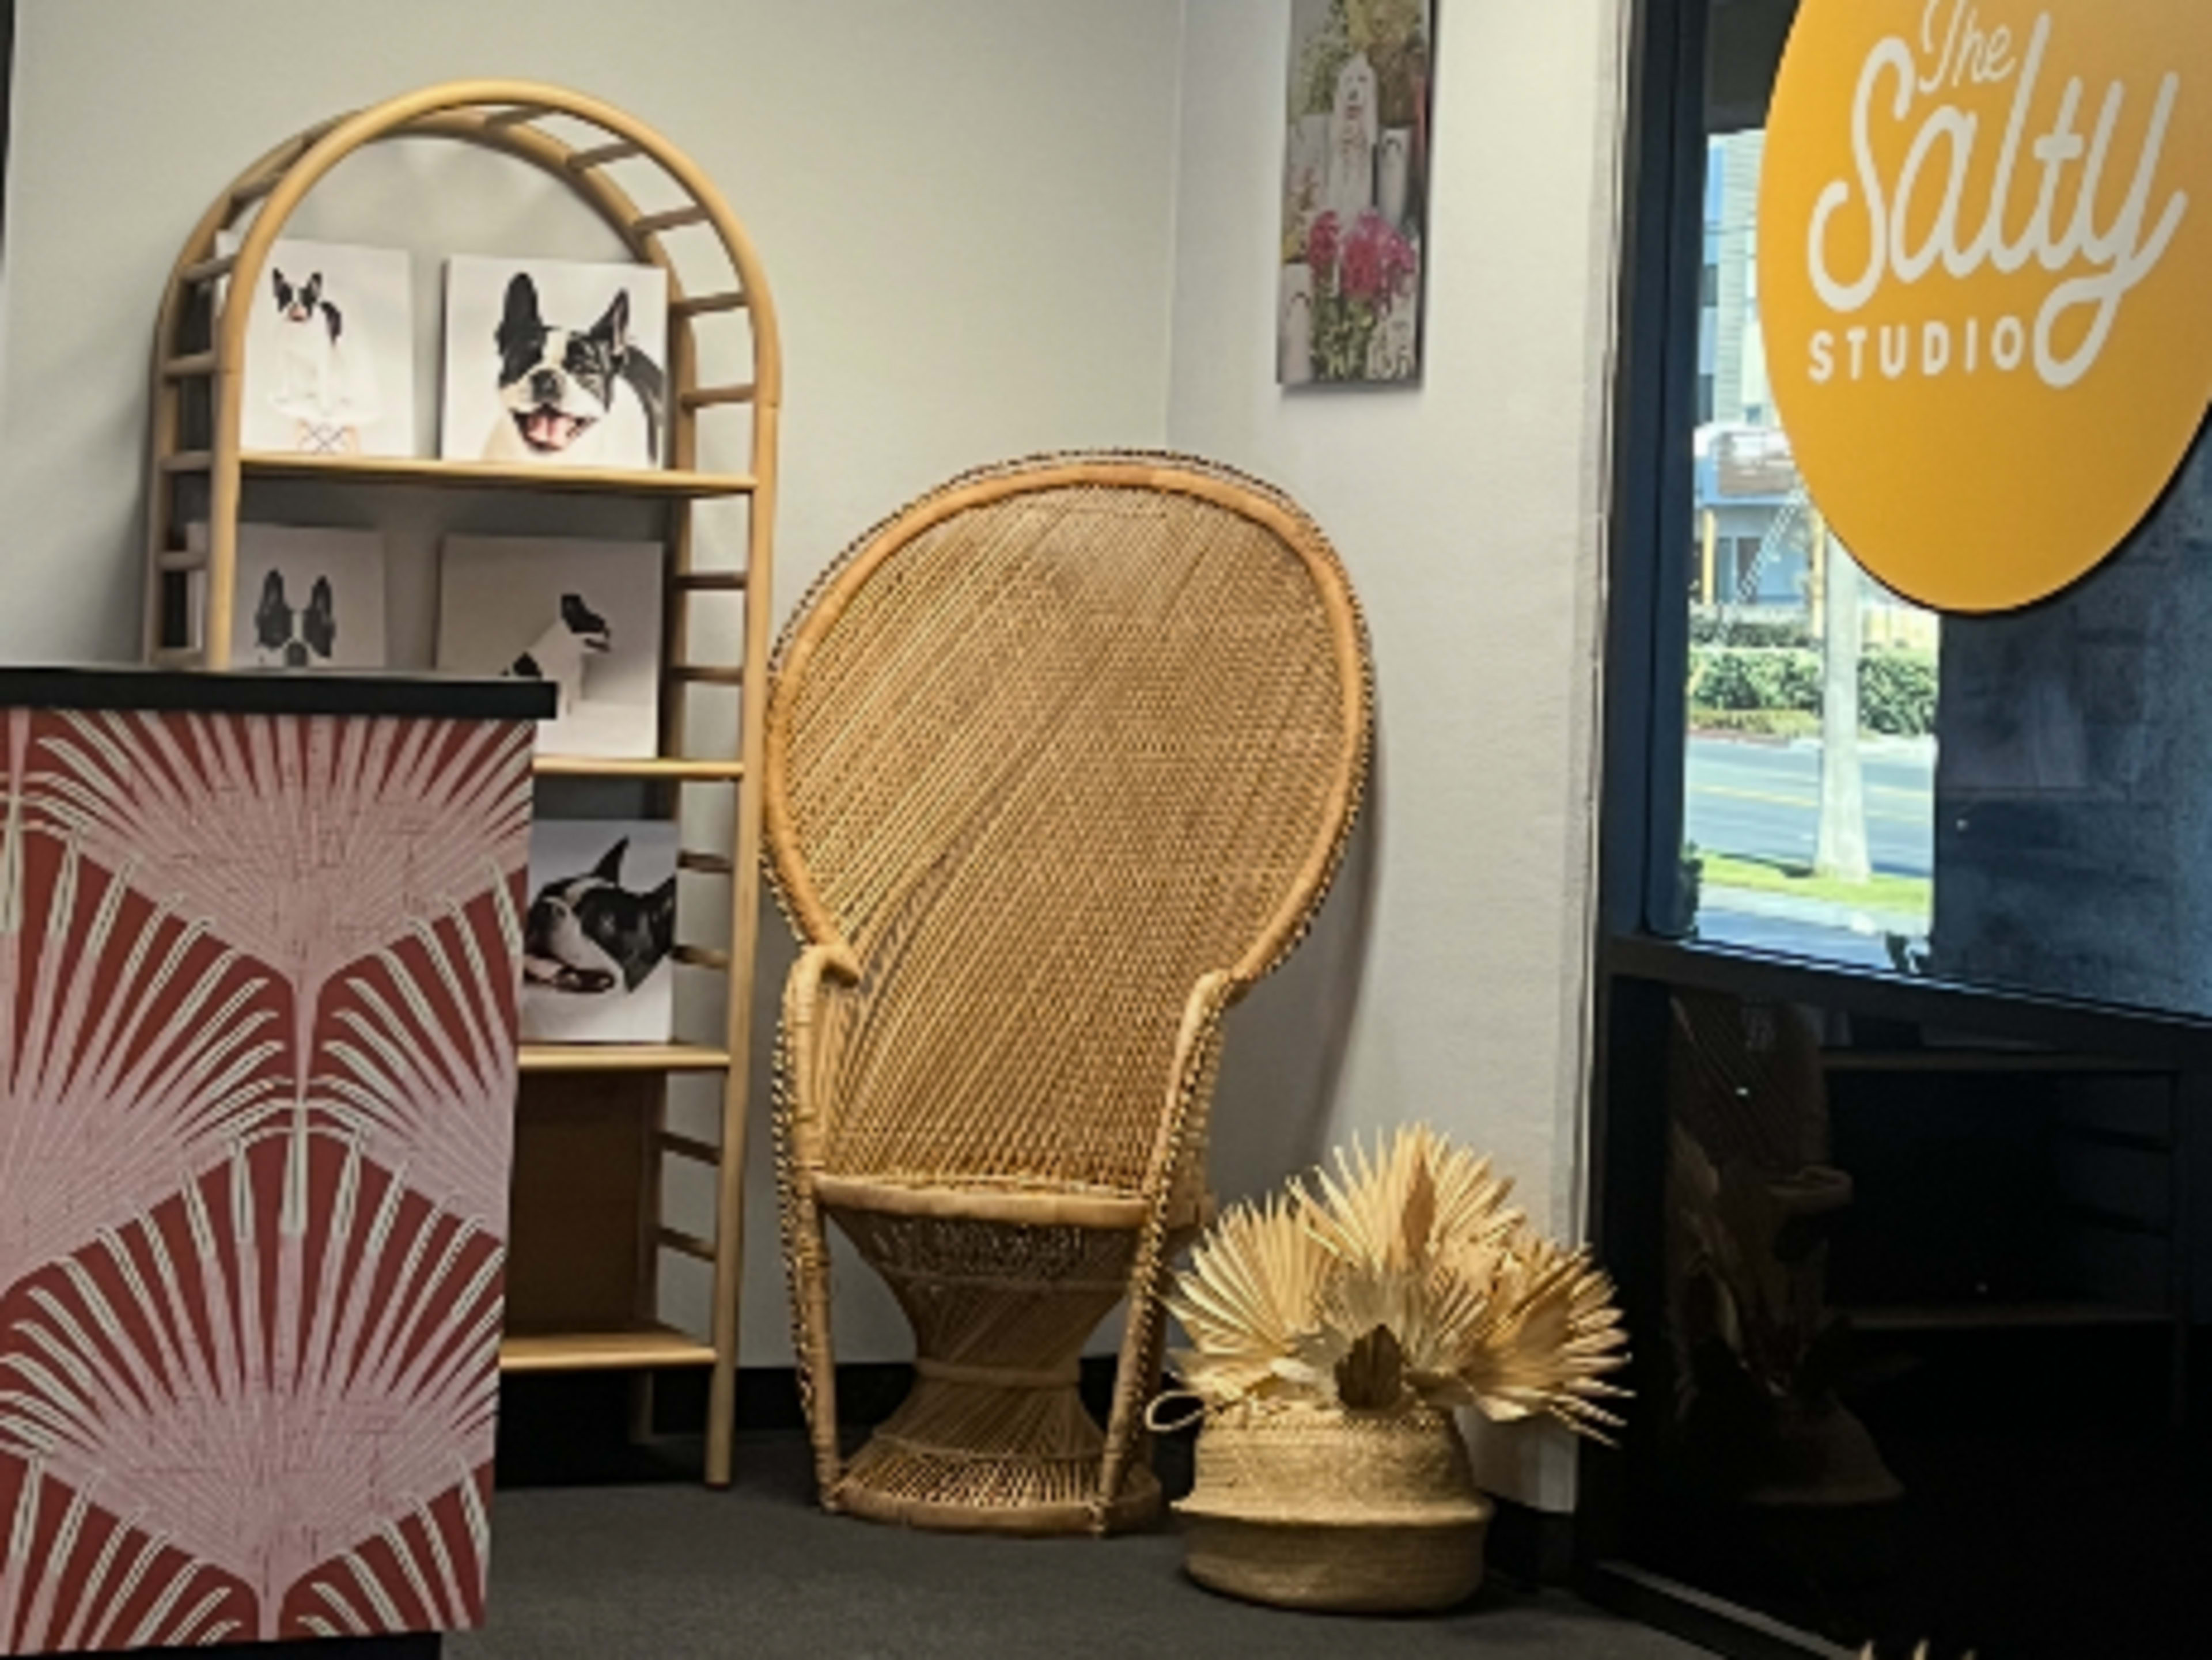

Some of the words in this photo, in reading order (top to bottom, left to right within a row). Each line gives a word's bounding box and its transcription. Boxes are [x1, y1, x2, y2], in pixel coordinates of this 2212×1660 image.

[1917, 0, 2016, 93] The
[1808, 12, 2189, 389] Salty
[1808, 314, 2025, 384] STUDIO
